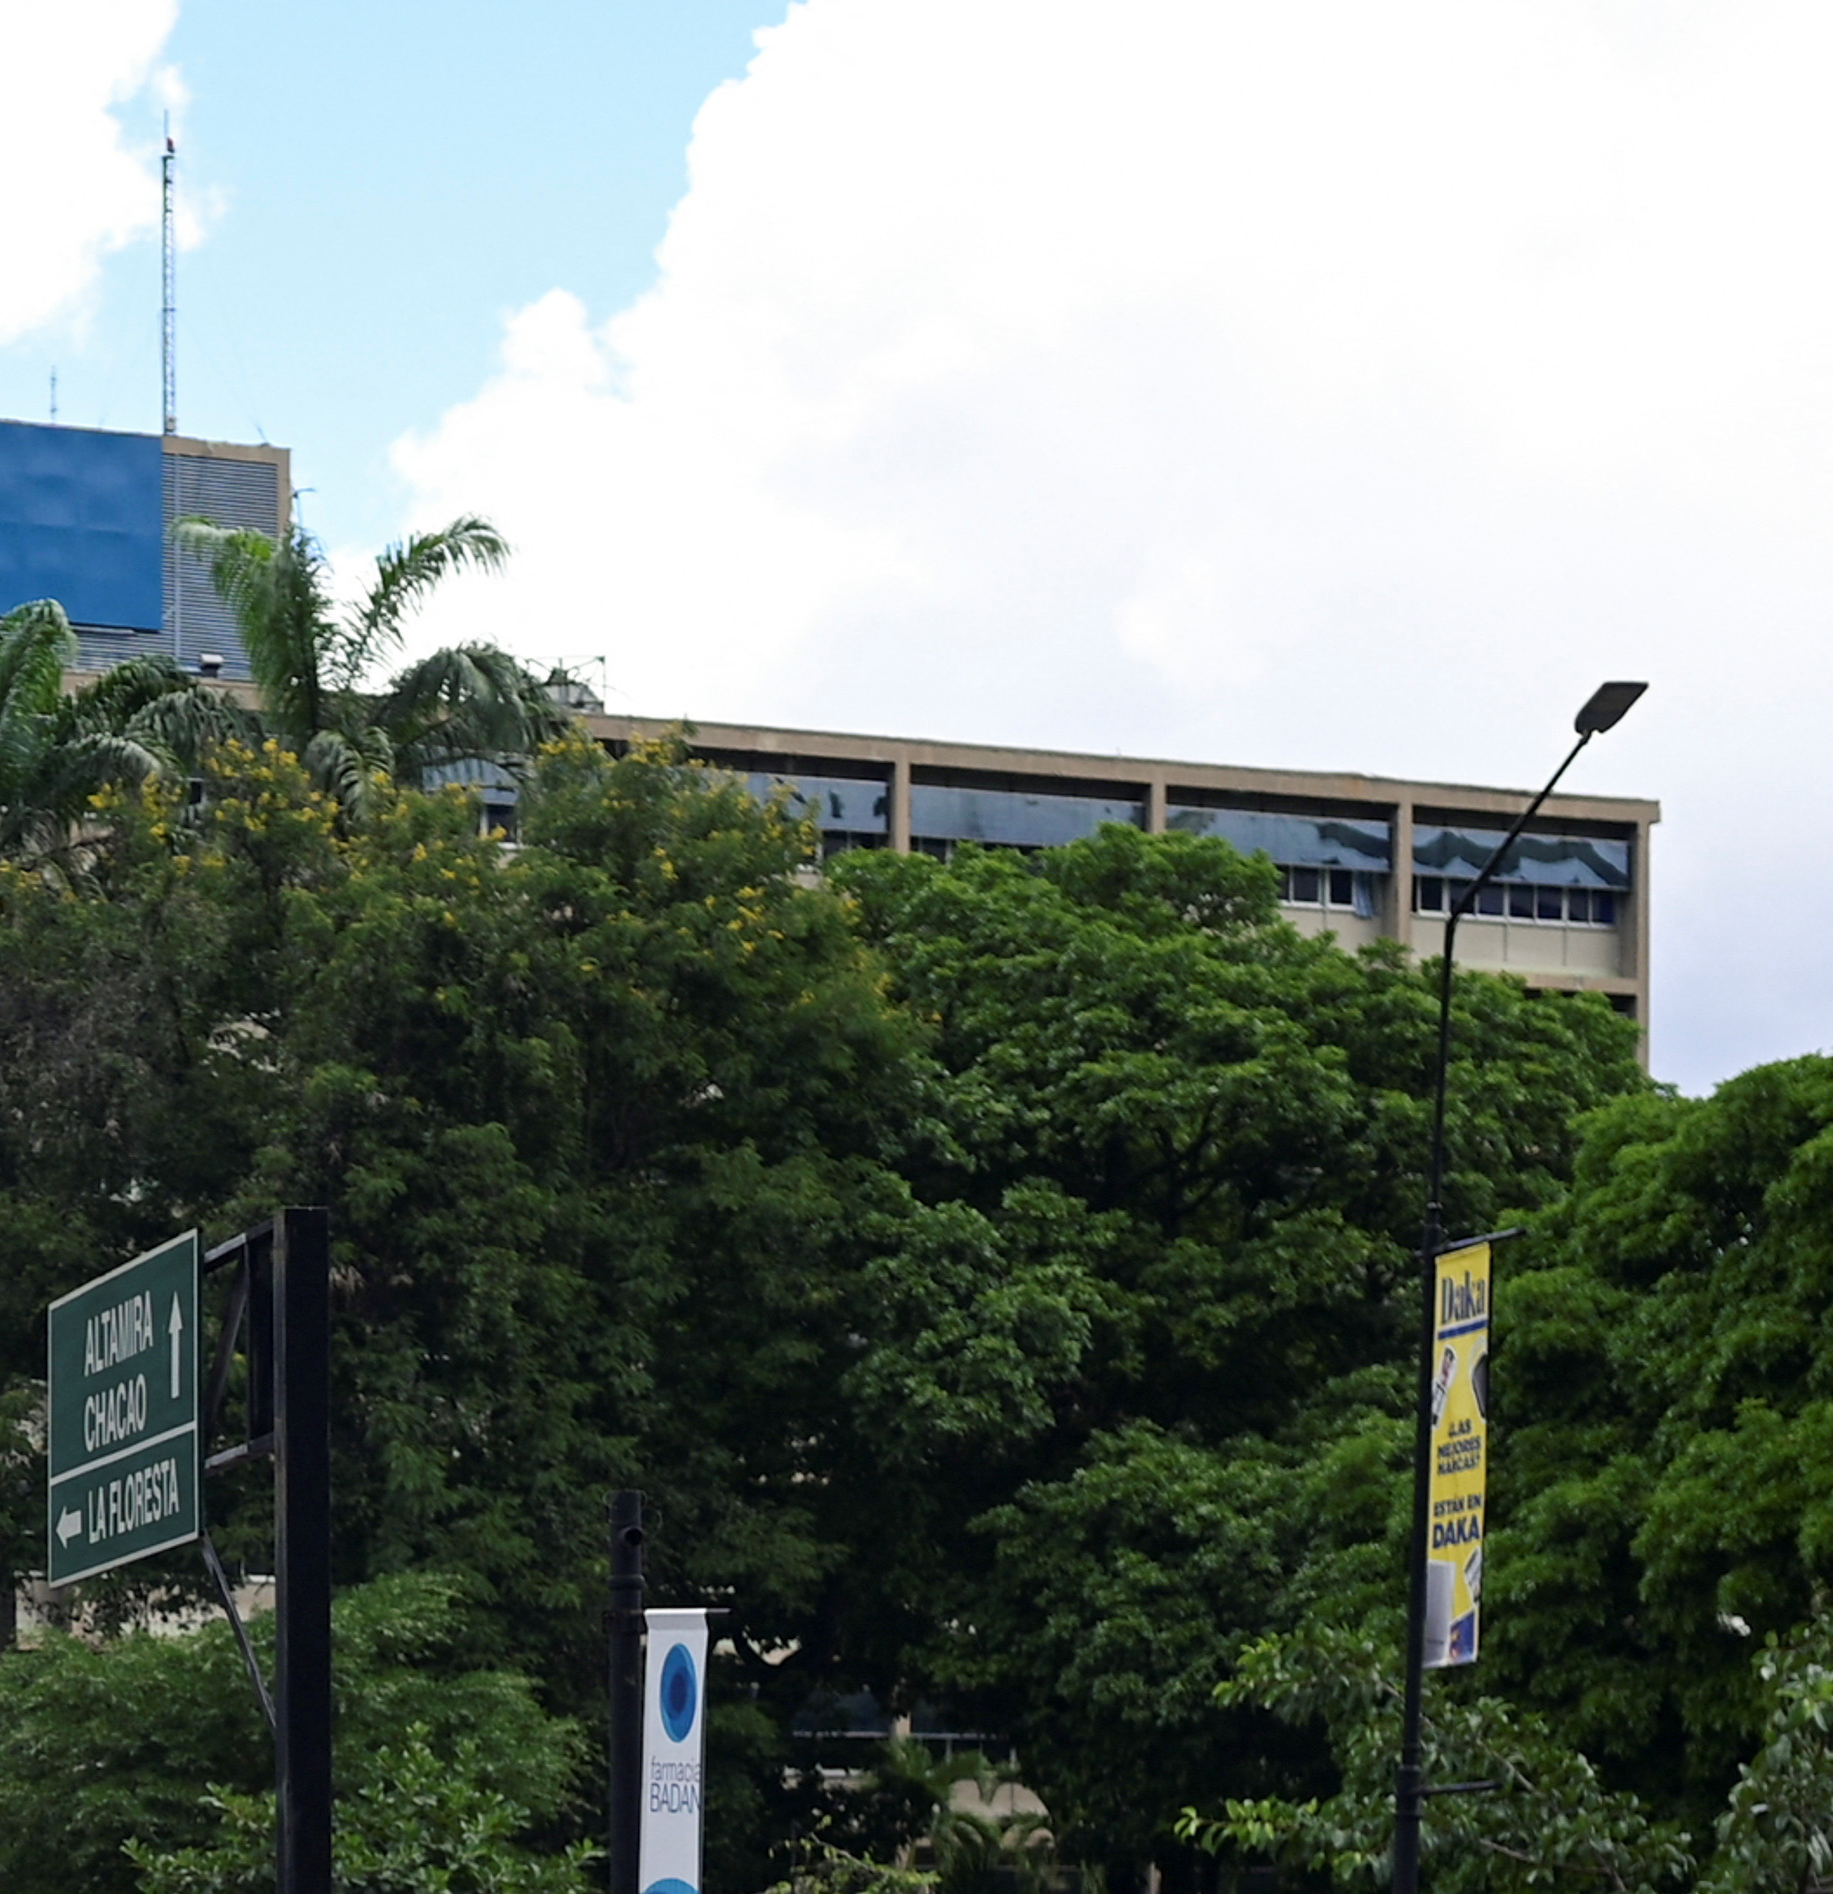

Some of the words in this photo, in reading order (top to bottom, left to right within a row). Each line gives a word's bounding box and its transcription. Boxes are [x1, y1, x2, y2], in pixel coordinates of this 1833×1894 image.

[1441, 1271, 1485, 1324] Daka
[85, 1290, 153, 1377] ALTAMIRA
[85, 1373, 147, 1453] CHACAO
[1437, 1436, 1481, 1457] MEJORES
[89, 1486, 107, 1544] LA
[109, 1458, 180, 1537] FLORESTA
[1467, 1494, 1482, 1510] EN
[1432, 1514, 1480, 1549] DAKA
[651, 1755, 701, 1782] farmacia
